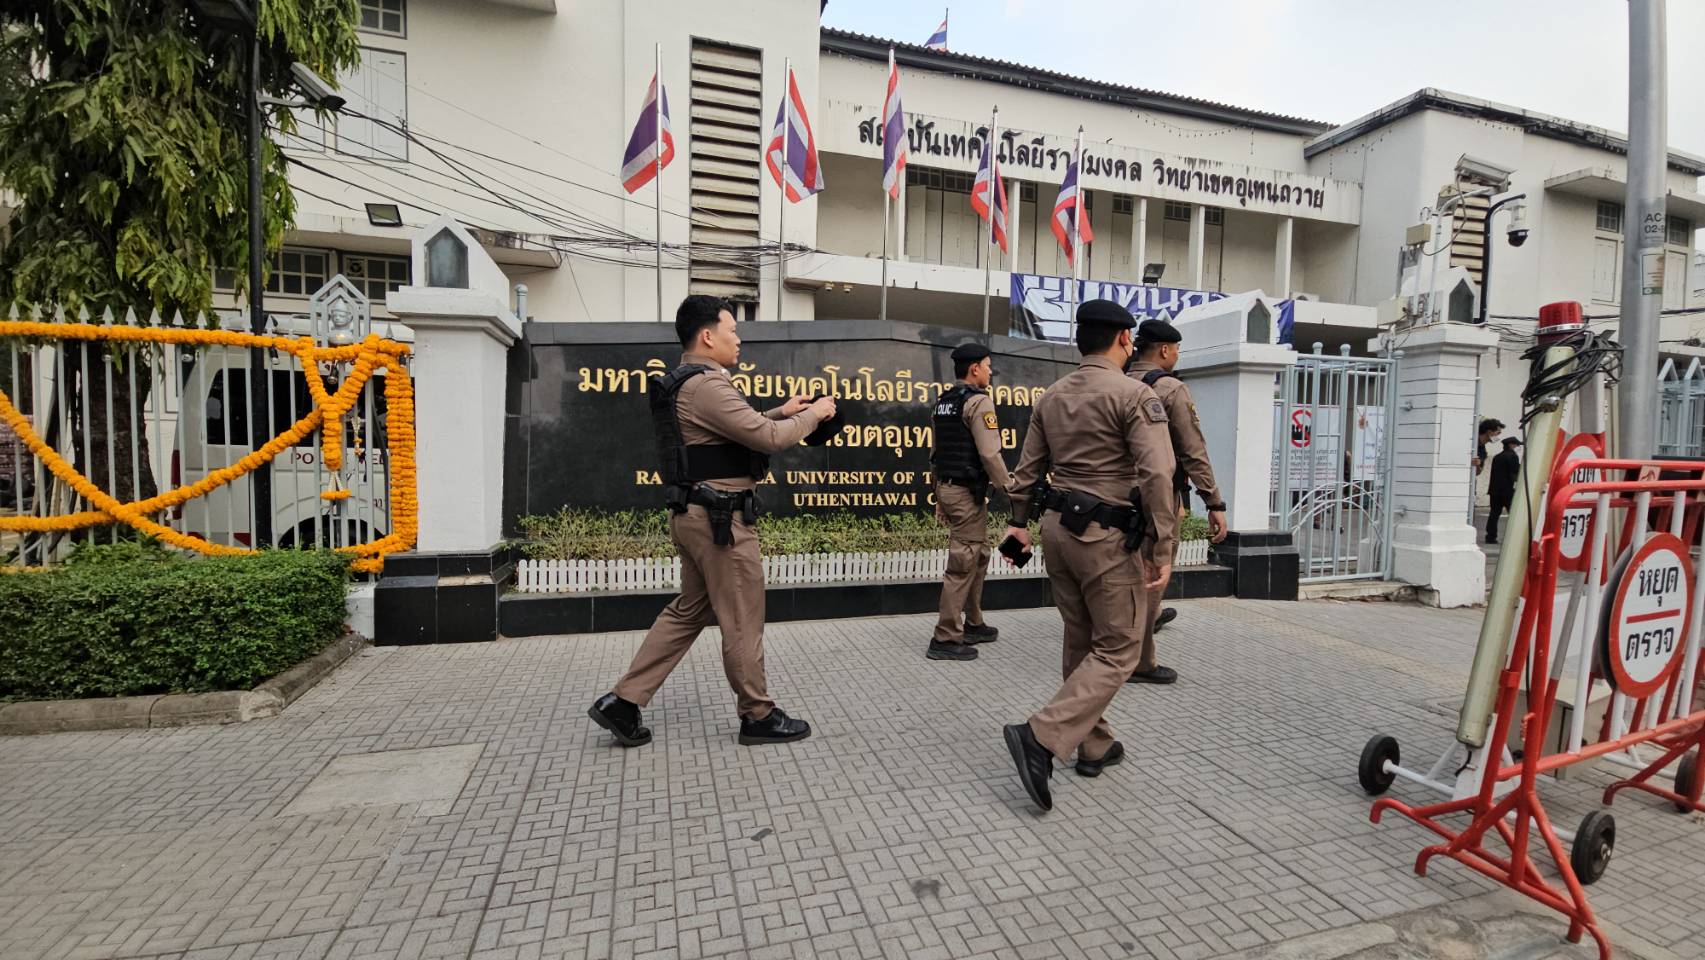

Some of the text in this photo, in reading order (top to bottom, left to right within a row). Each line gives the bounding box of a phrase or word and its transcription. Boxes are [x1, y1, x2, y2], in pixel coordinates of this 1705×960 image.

[1152, 158, 1325, 208] วิทยาเขตอุเทนถวาย
[786, 471, 887, 485] UNIVERSITY
[893, 471, 915, 484] OF
[793, 492, 917, 506] UTHENTHAWAI
[1639, 566, 1680, 607] หยุด
[1625, 626, 1675, 662] ตรวจ
